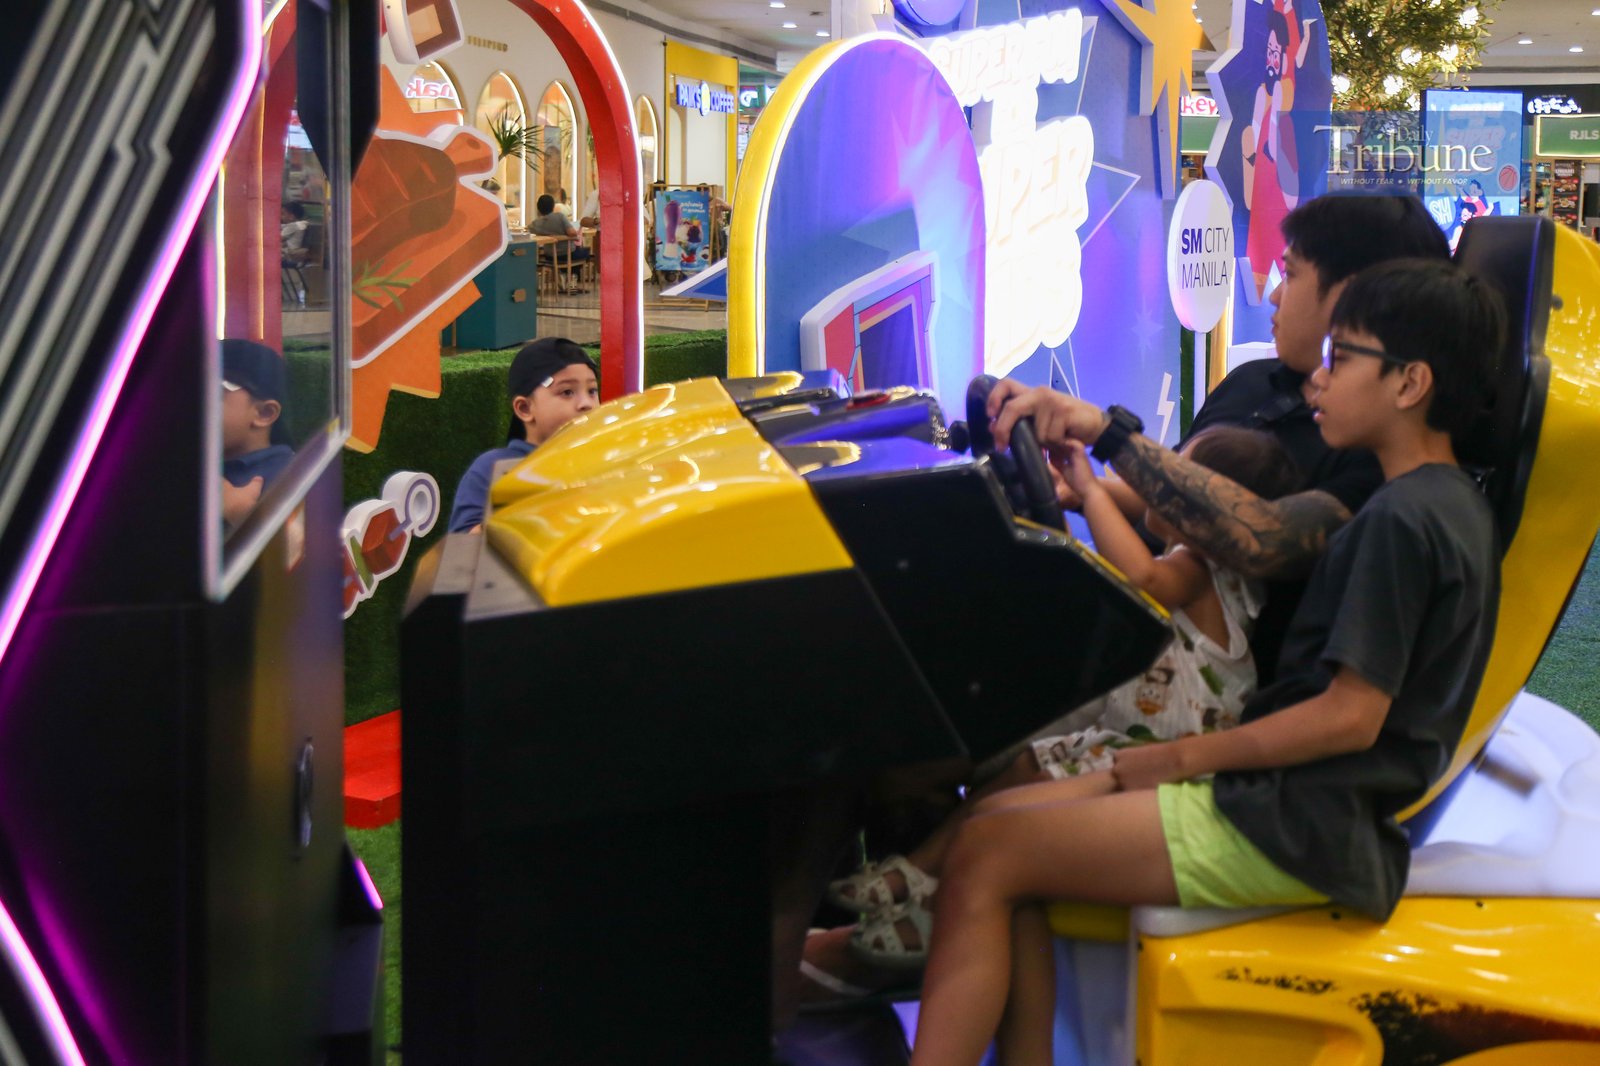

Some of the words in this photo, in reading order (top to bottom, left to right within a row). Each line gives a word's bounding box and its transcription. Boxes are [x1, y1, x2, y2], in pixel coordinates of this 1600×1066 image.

[676, 83, 701, 109] PAIK'S
[709, 89, 735, 113] COFFEE
[1181, 228, 1202, 255] SM
[1204, 227, 1230, 253] CITY
[1181, 260, 1228, 290] MANILA
